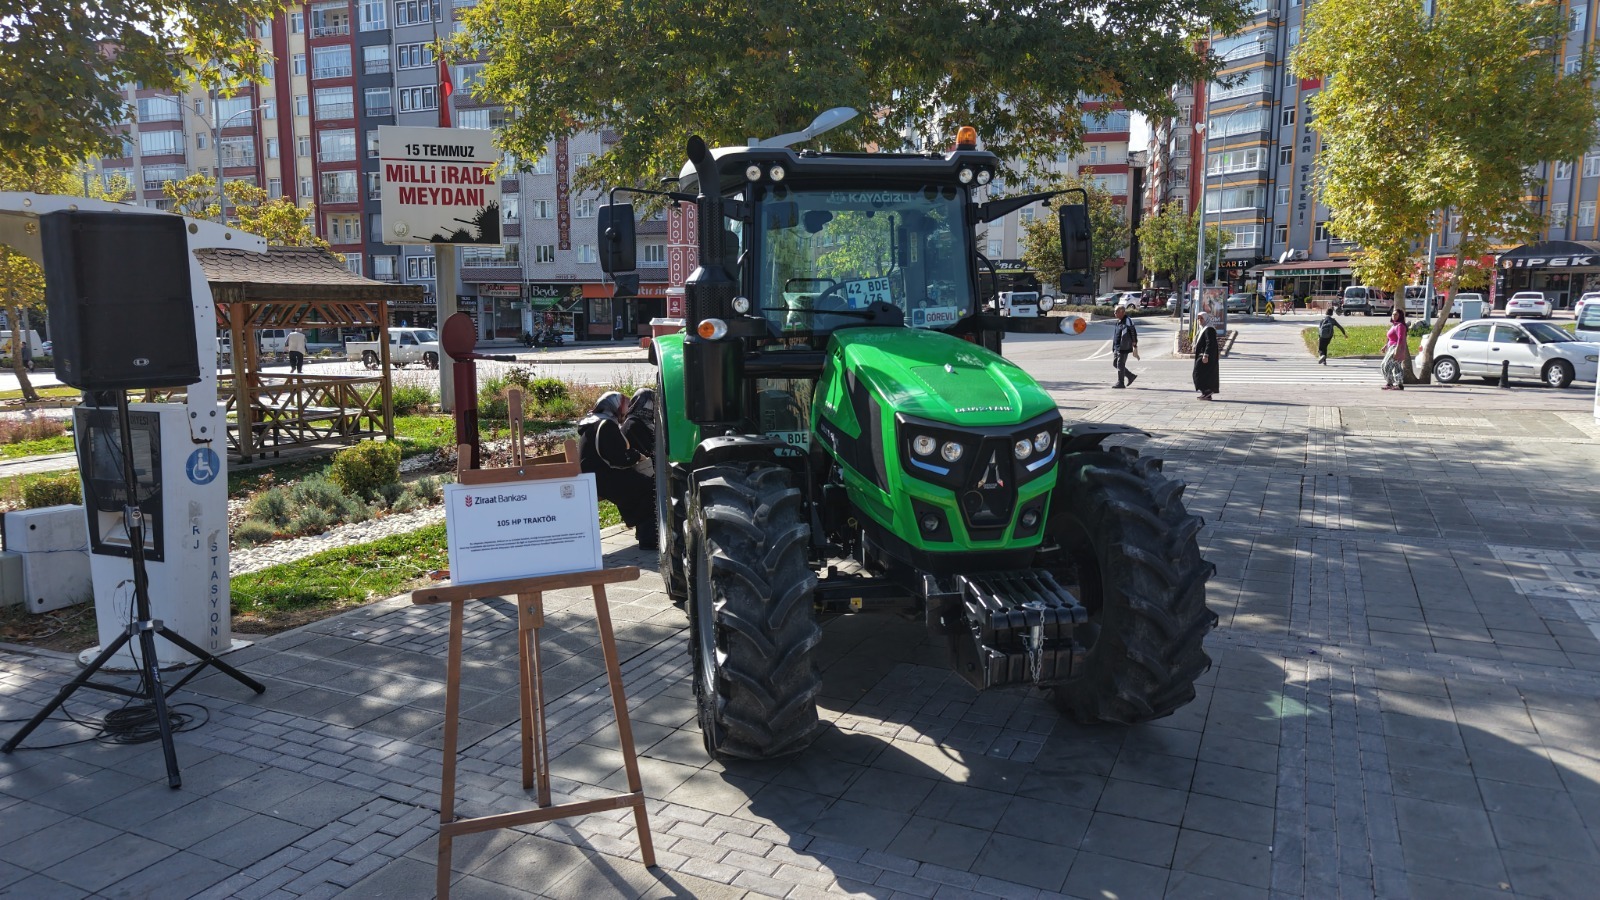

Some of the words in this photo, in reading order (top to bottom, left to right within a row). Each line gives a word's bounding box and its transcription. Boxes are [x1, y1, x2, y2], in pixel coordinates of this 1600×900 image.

[405, 143, 420, 156] 15
[423, 144, 475, 158] TEMMUZ
[399, 186, 485, 207] MEYDANI
[848, 191, 912, 203] KAYAĞIZLI
[1298, 164, 1309, 219] SİTESİ
[533, 286, 558, 298] Beyde
[848, 284, 862, 295] 42
[868, 280, 888, 292] BDE
[863, 294, 884, 305] 476
[926, 311, 957, 323] GÖREVLİ
[787, 433, 808, 444] BDE
[474, 496, 497, 505] Ziraat
[498, 494, 528, 503] Bankası
[497, 519, 510, 527] 105
[512, 518, 522, 526] HP
[524, 515, 557, 525] TRAKTÖR
[210, 543, 219, 650] STASYONU
